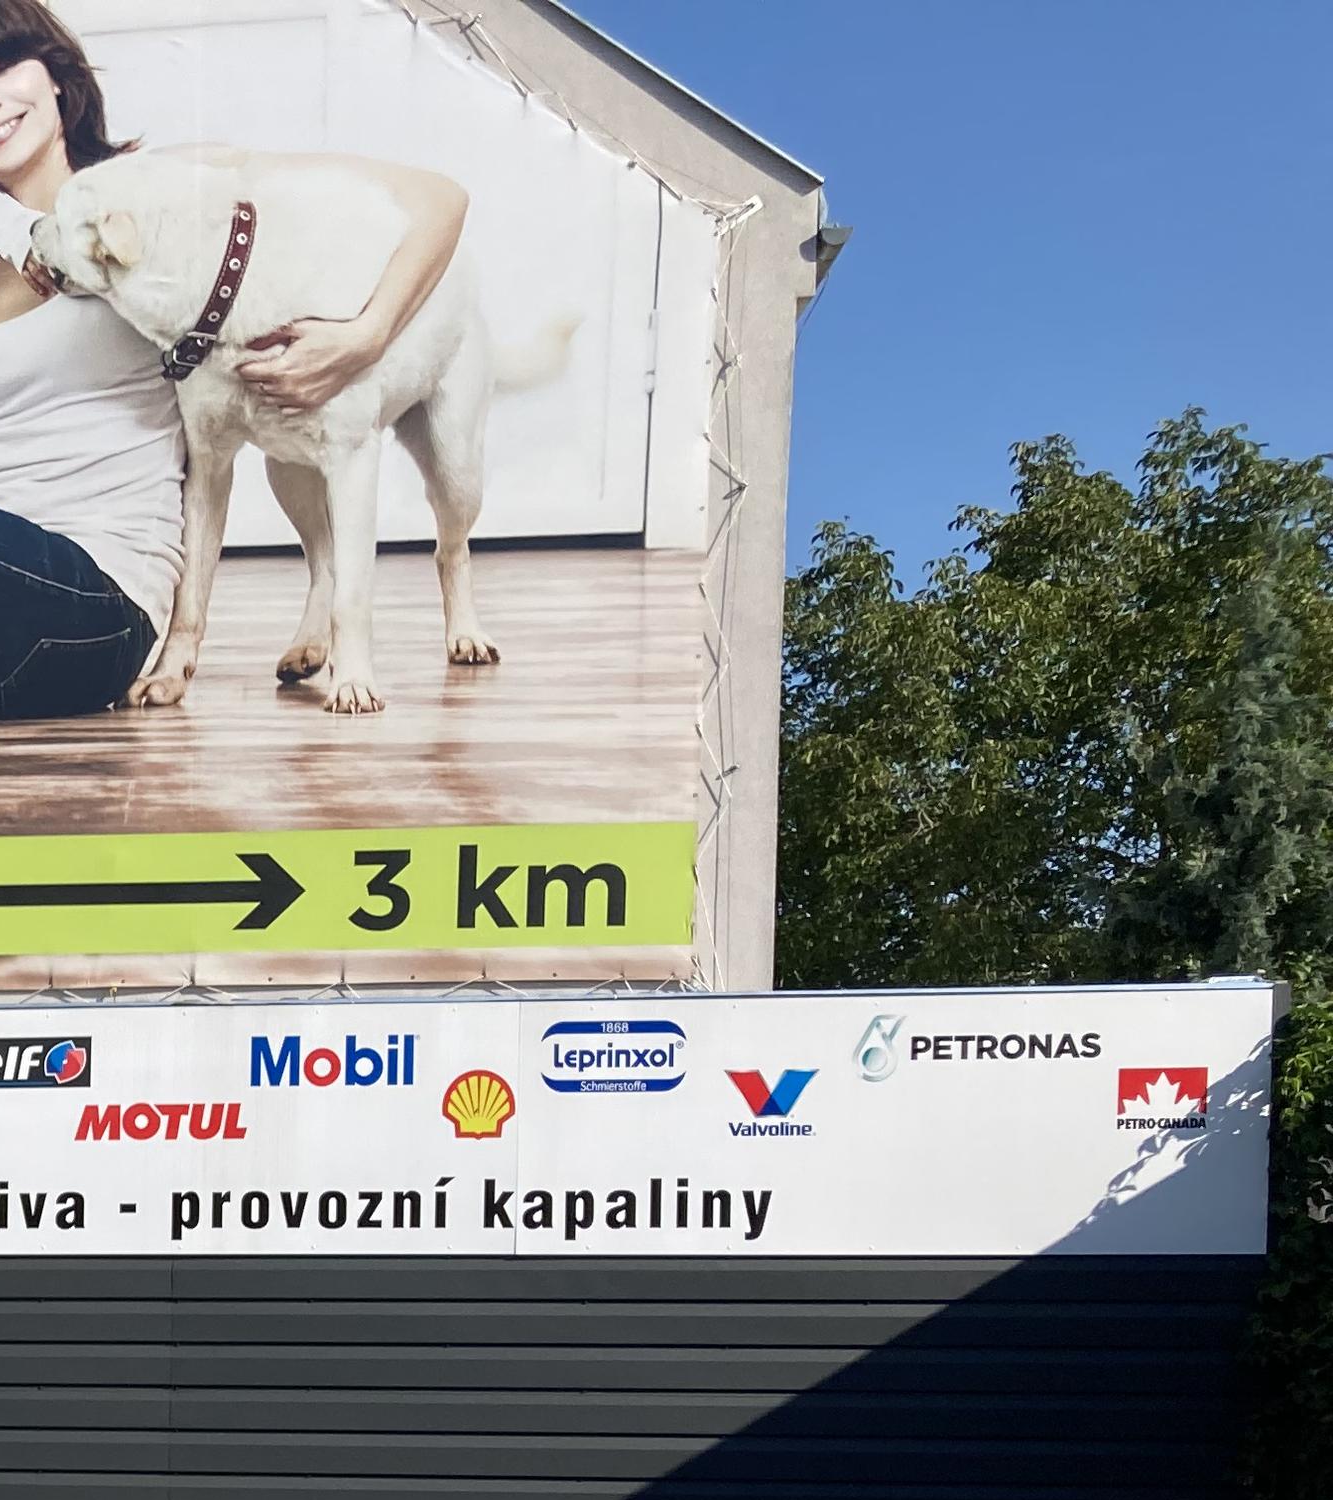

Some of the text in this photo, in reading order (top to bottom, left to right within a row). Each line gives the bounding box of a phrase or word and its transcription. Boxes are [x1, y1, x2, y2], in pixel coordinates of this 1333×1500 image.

[348, 848, 412, 932] 3
[457, 844, 628, 929] km
[600, 1022, 630, 1034] 1868
[250, 1034, 414, 1087] Mobil
[910, 1033, 1102, 1061] PETRONAS
[580, 1079, 647, 1093] Schmierstoffe
[74, 1102, 248, 1142] MOTUL
[728, 1122, 814, 1138] Valvoline
[119, 1203, 137, 1214] -
[171, 1176, 456, 1241] provozní
[483, 1178, 773, 1241] kapaliny
